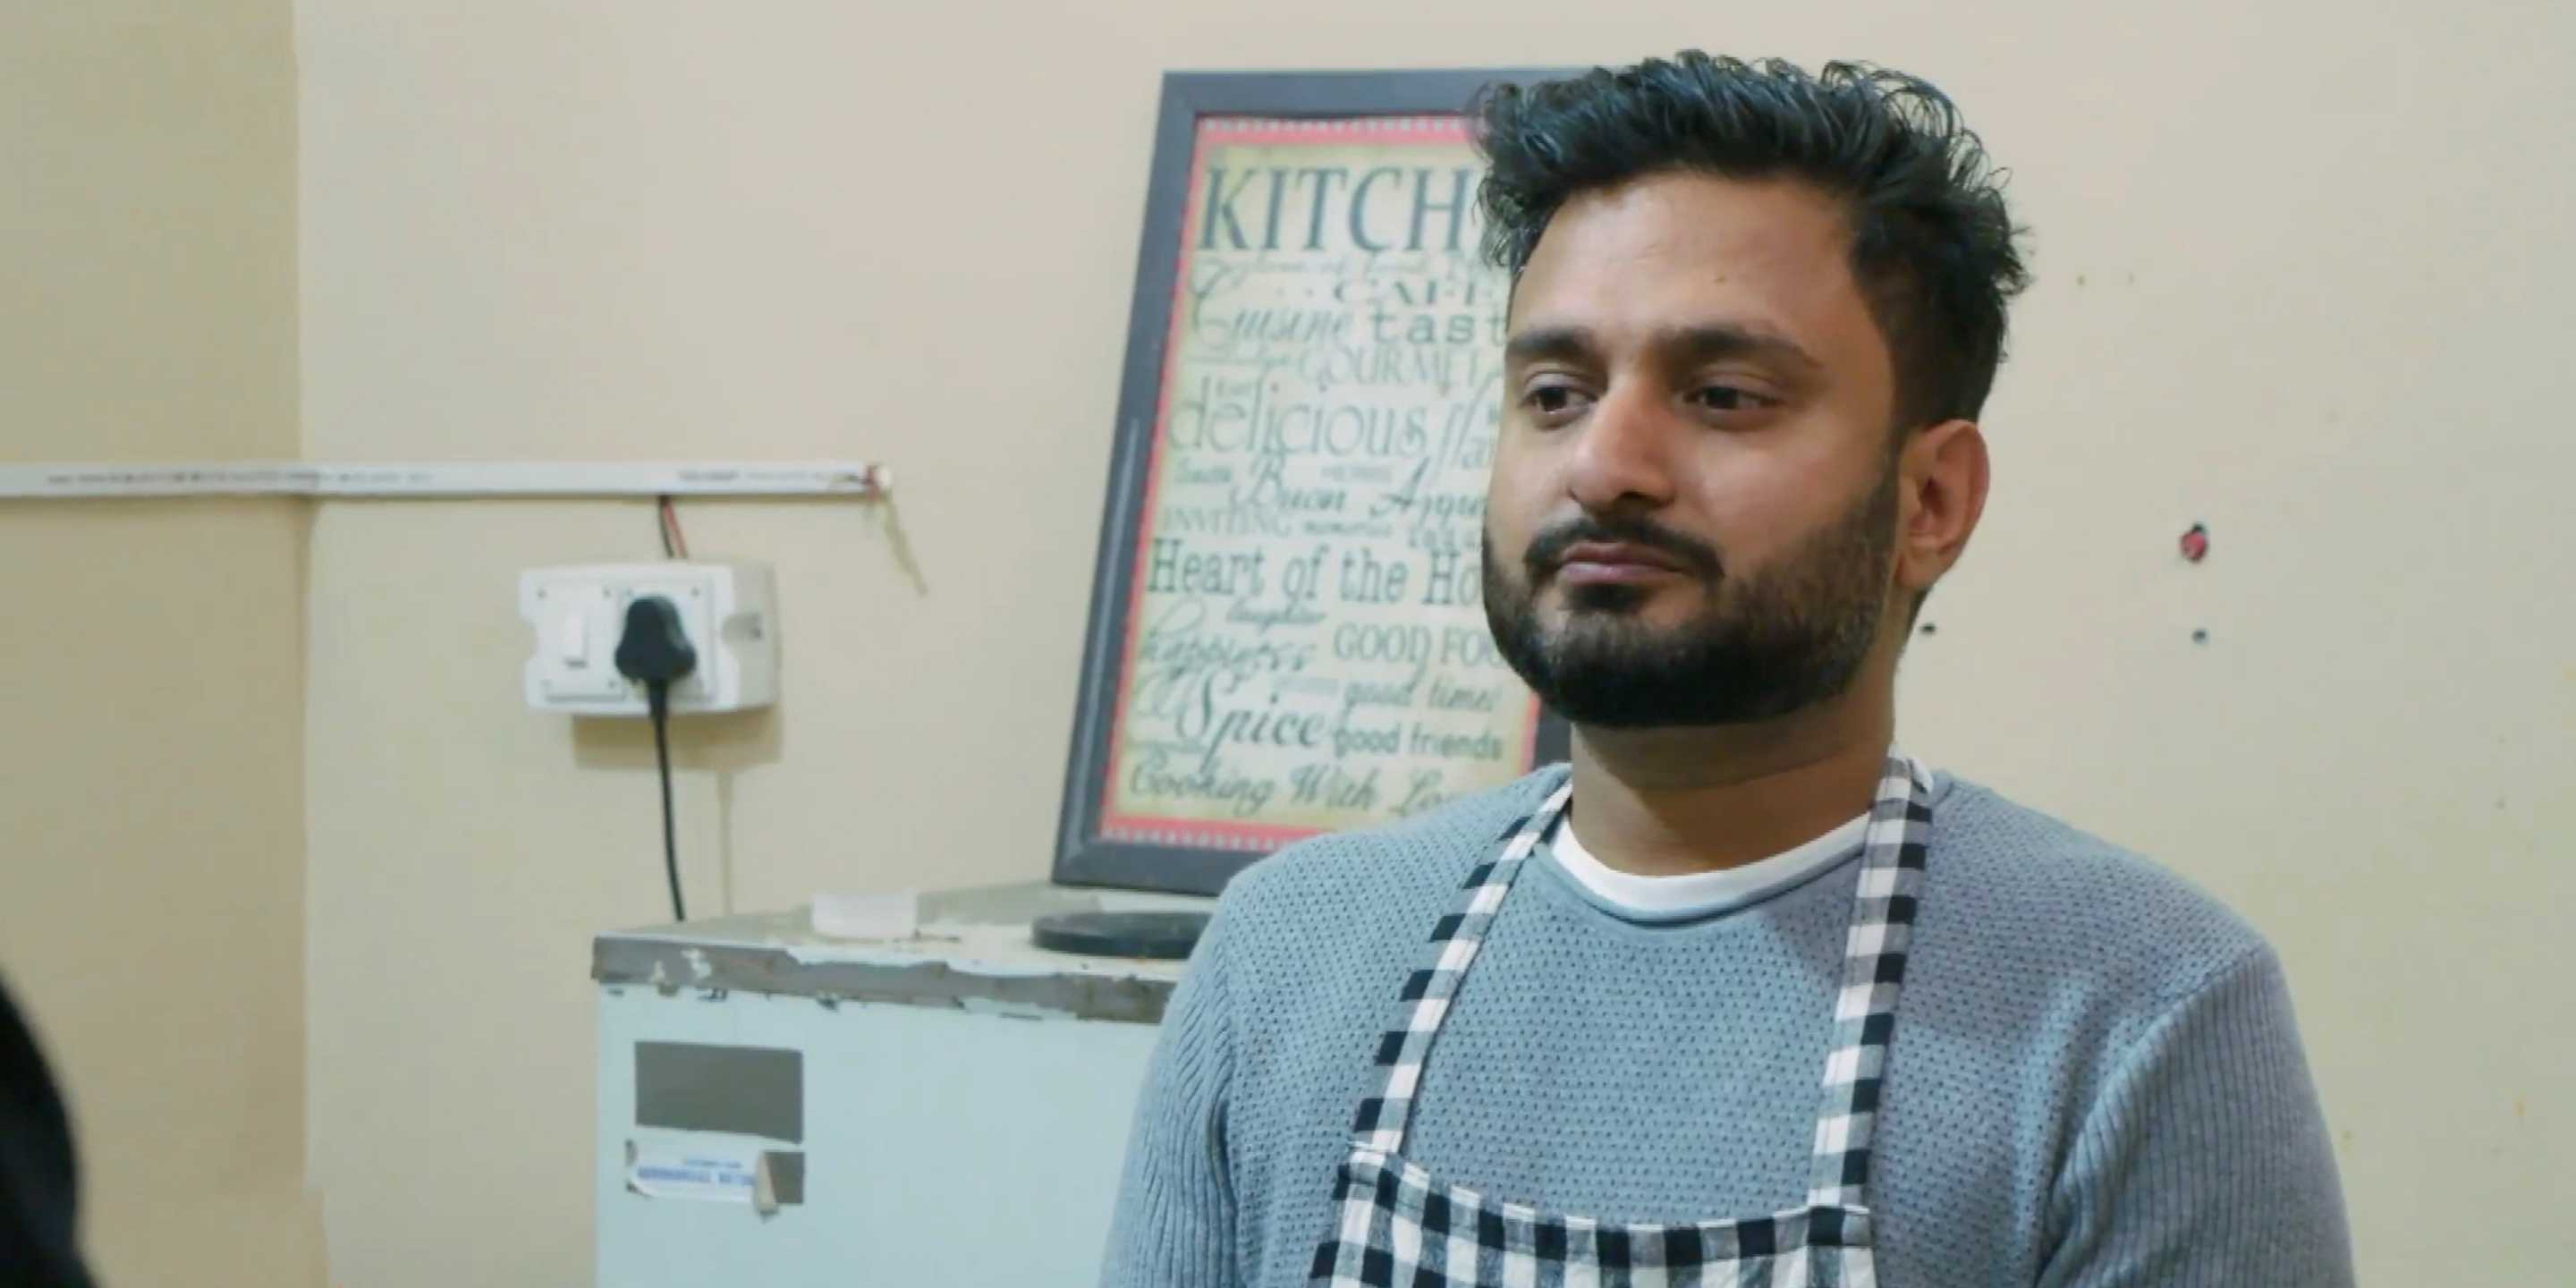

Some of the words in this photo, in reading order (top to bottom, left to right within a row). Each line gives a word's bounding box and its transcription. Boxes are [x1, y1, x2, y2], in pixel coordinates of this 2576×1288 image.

[1199, 167, 1475, 252] KITCH
[1168, 376, 1428, 458] delicious
[1148, 538, 1267, 594] Heart
[1282, 544, 1330, 597] of
[1340, 548, 1409, 602] the
[1421, 551, 1485, 606] Ho
[1333, 624, 1433, 693] GOOD
[1441, 626, 1506, 669] FOO
[1174, 669, 1325, 776] Spice
[1334, 722, 1402, 758] good
[1410, 721, 1504, 766] friends
